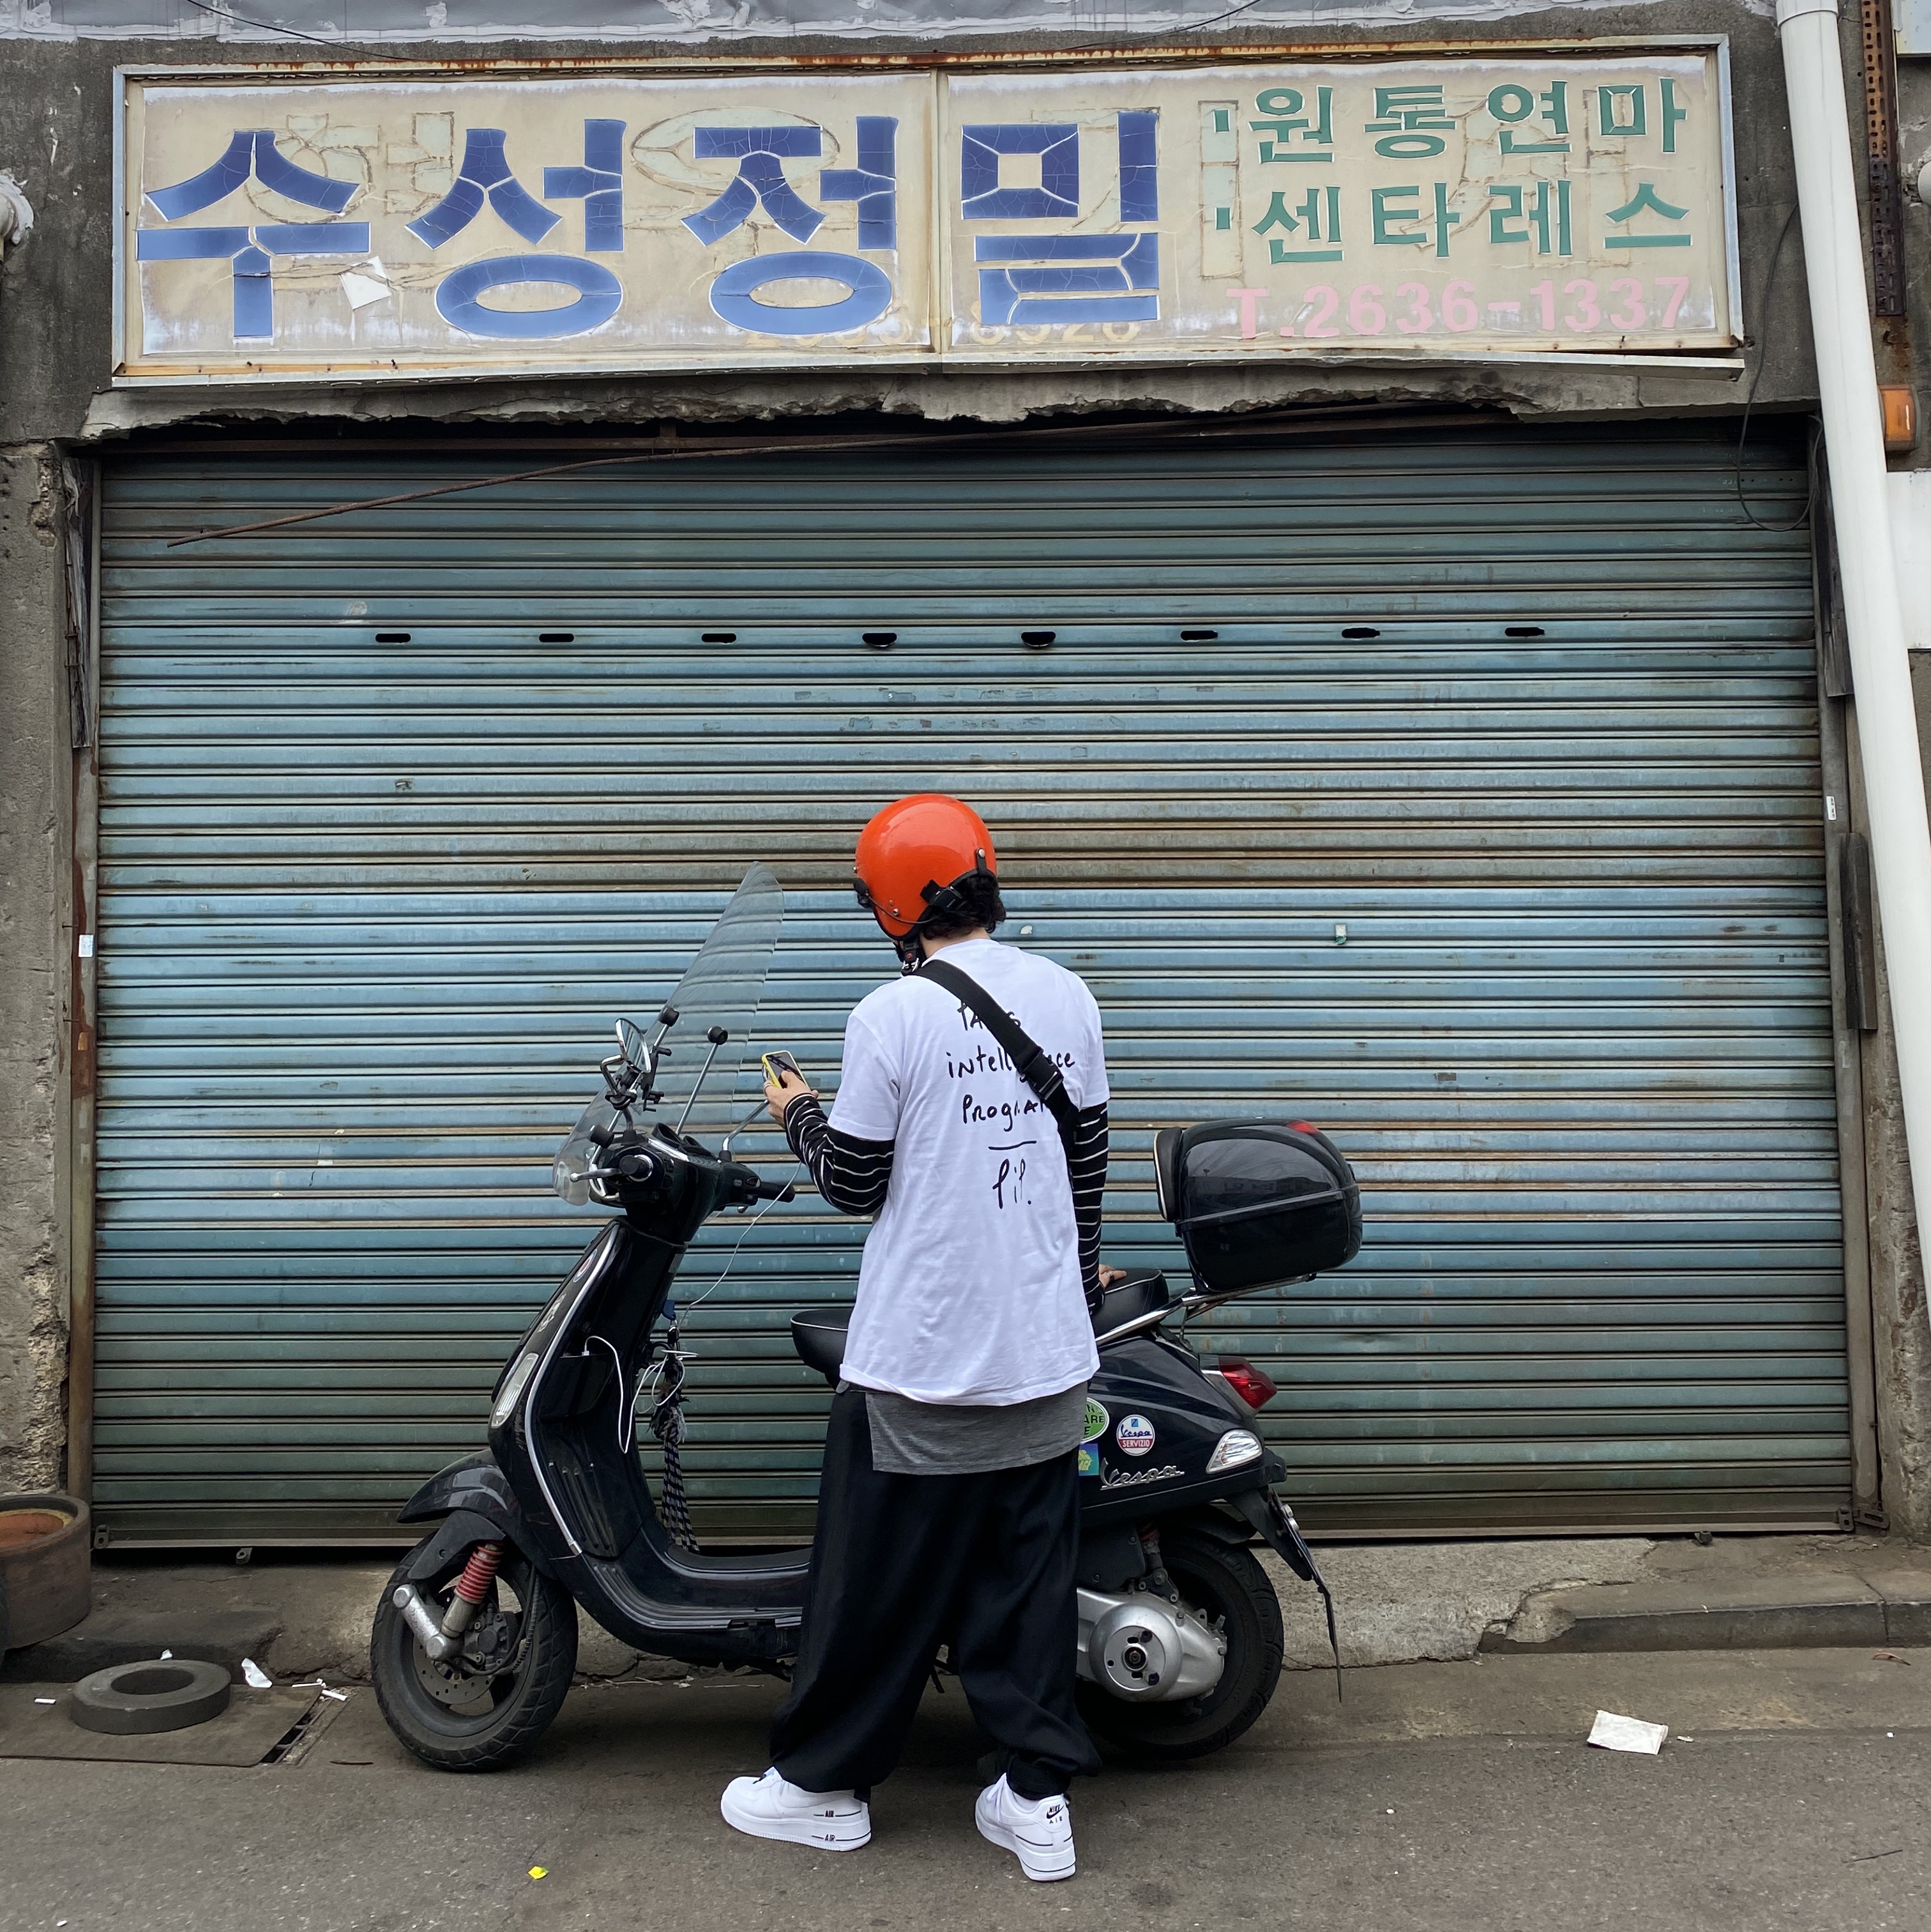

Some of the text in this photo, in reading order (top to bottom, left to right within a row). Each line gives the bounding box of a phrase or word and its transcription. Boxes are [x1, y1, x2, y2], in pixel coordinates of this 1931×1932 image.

[1248, 77, 1688, 165] 원통연마
[136, 110, 1160, 340] 수상정밀
[1251, 179, 1693, 265] 센타레스
[1225, 275, 1691, 340] T.2636-1337
[1120, 1424, 1153, 1438] Vespa
[1122, 1440, 1151, 1448] SERVIZIO
[1099, 1457, 1185, 1491] Vespa
